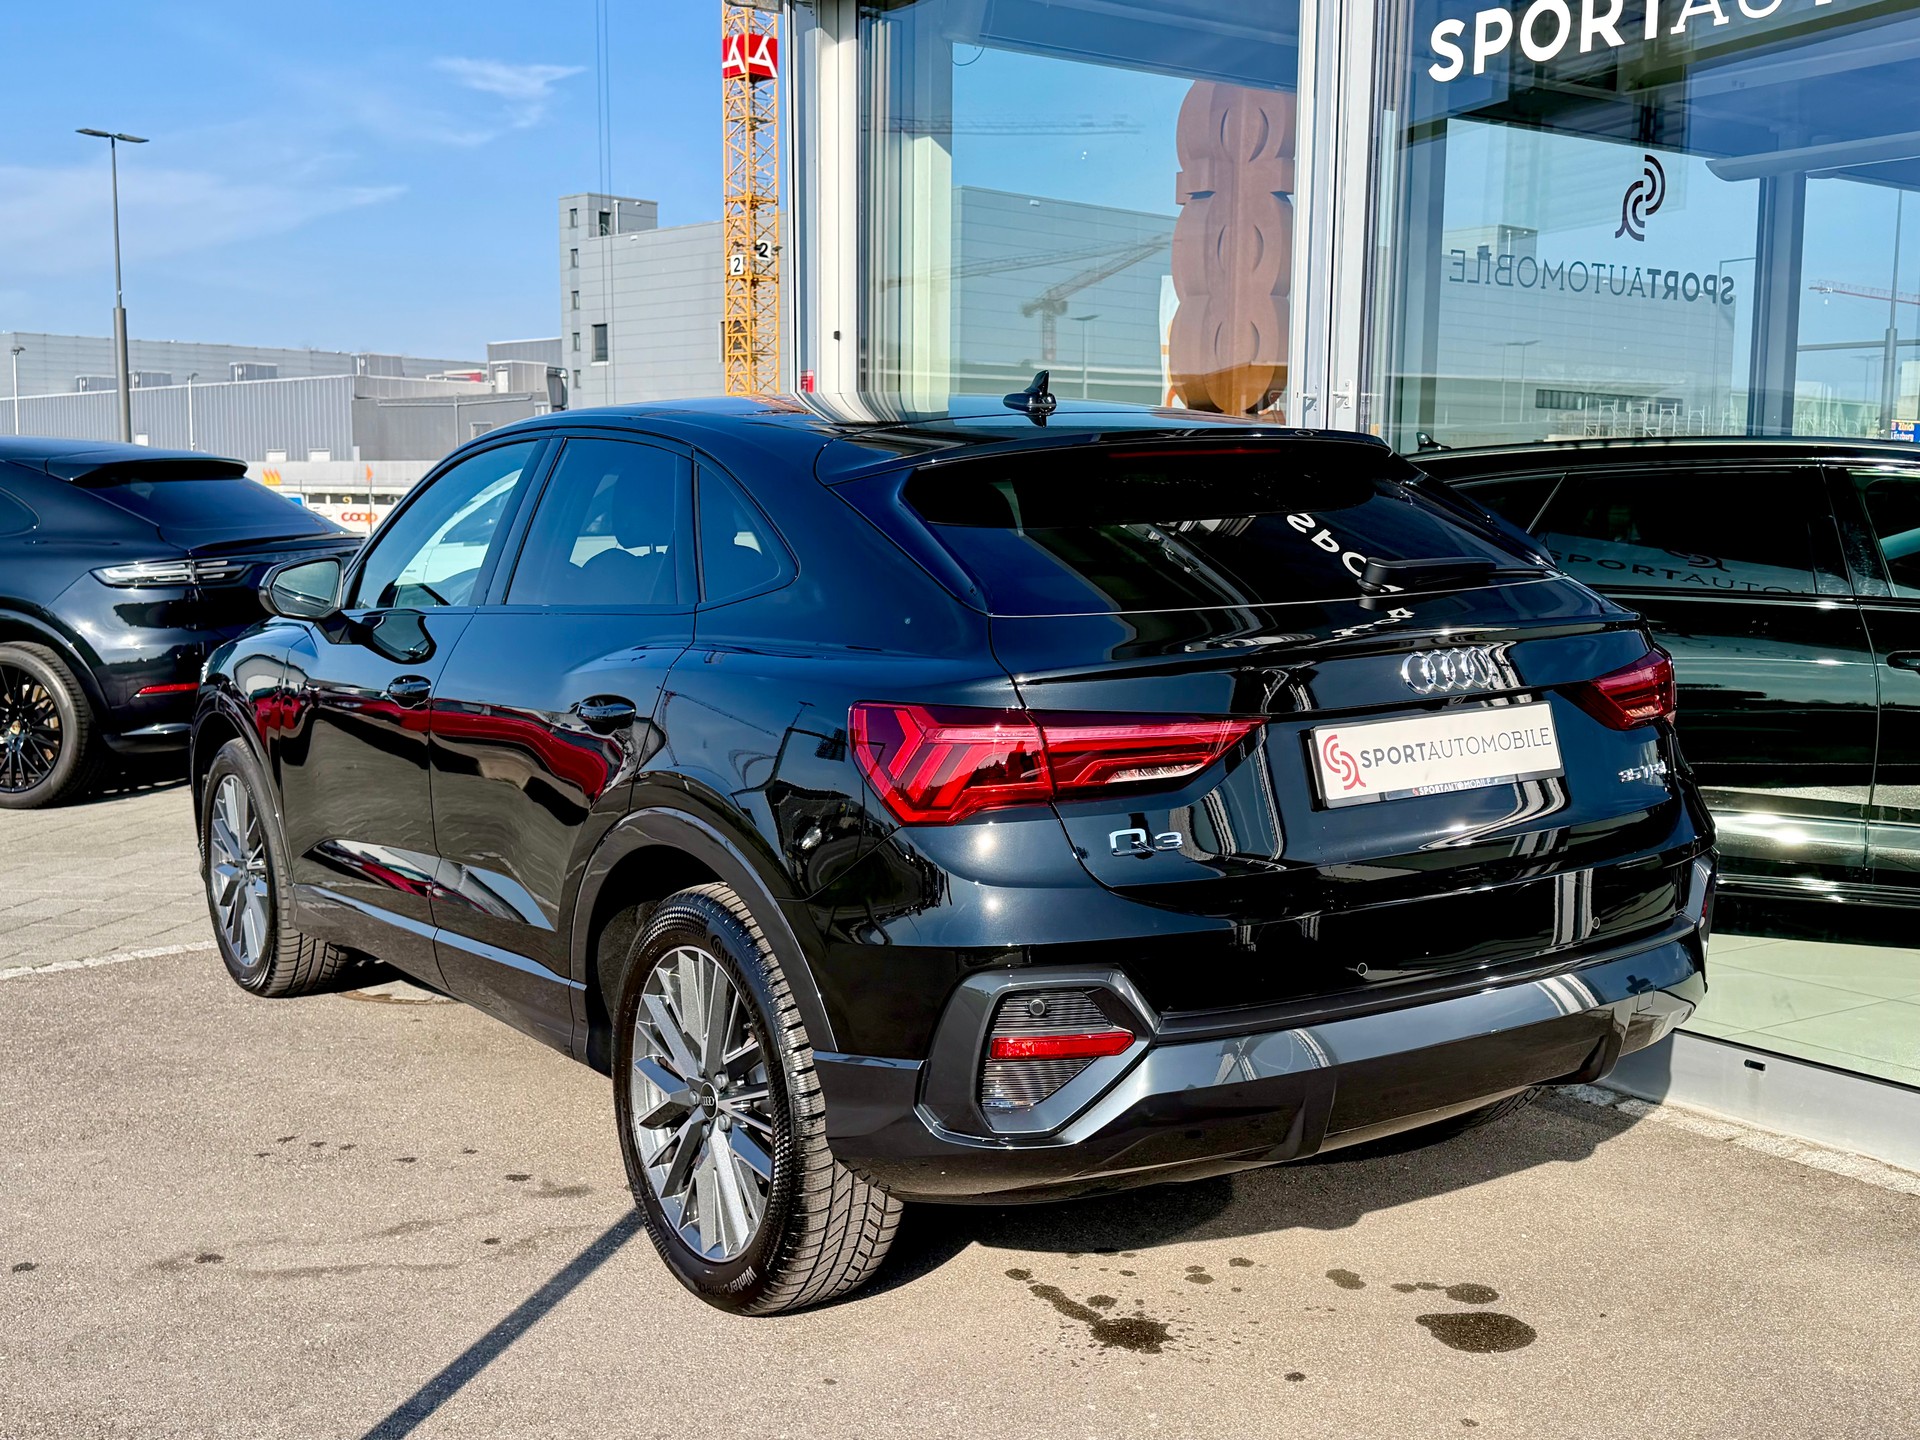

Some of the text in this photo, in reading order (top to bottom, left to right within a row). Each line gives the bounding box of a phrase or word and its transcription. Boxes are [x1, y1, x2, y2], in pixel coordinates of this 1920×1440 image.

[758, 243, 768, 259] 2
[733, 257, 741, 272] 2
[341, 511, 378, 524] coop
[1361, 726, 1553, 769] SPORTAUTOMOBILE
[1109, 827, 1184, 857] Q3
